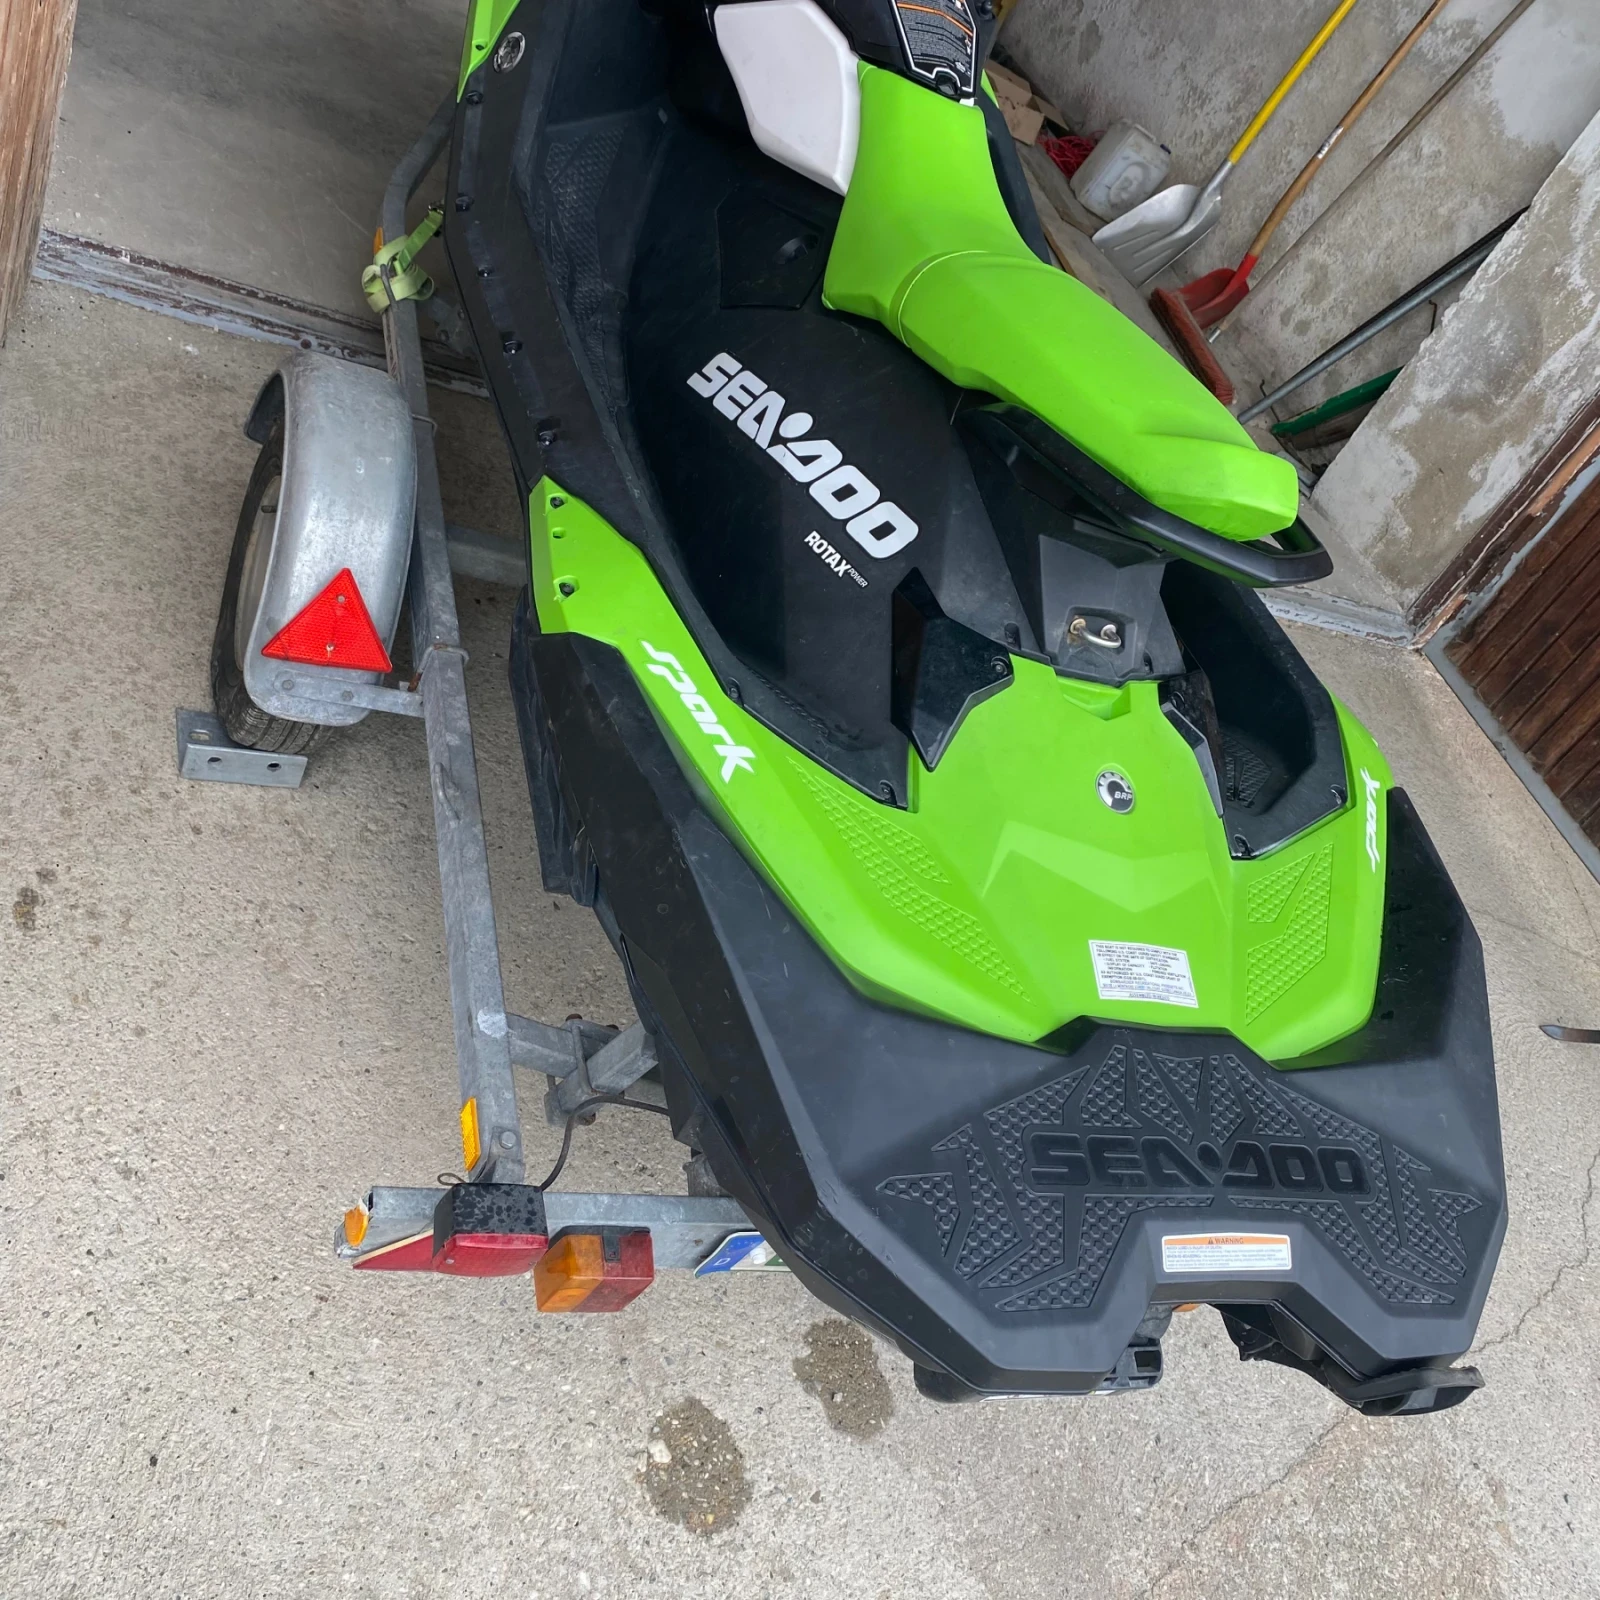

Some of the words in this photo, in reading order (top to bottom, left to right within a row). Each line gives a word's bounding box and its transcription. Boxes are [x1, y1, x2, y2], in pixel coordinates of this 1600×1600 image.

[804, 530, 850, 578] ROTAX
[846, 567, 868, 588] POWER
[1114, 791, 1133, 801] BRP
[1214, 1237, 1244, 1245] WARNING
[714, 1257, 731, 1266] D
